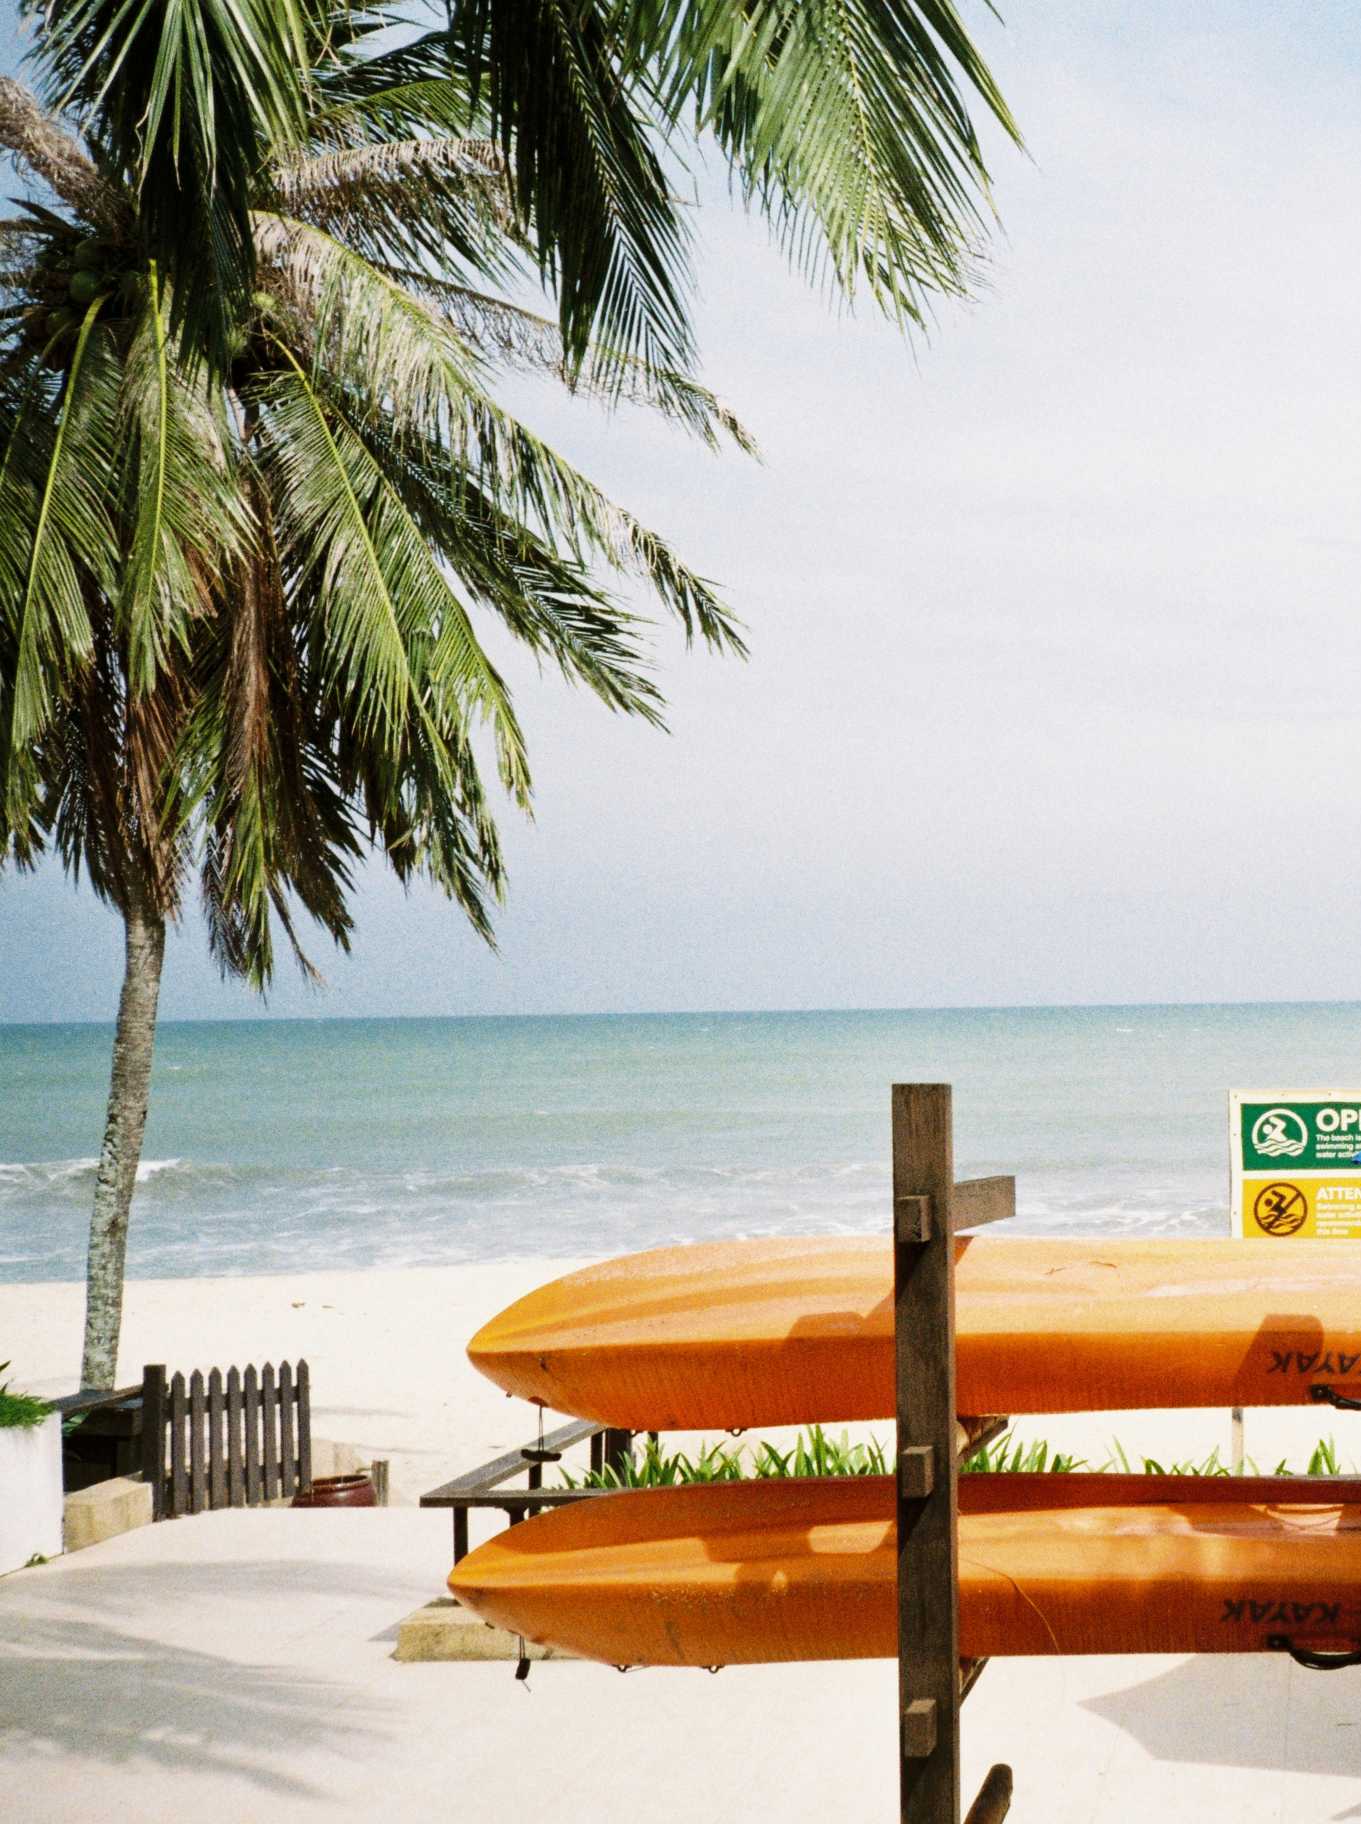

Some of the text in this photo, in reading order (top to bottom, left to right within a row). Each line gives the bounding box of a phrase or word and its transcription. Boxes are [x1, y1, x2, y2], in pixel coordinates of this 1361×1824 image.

[1316, 1134, 1330, 1142] The
[1331, 1134, 1354, 1142] beach
[1354, 1134, 1361, 1142] is
[1316, 1143, 1354, 1152] swimming
[1220, 1599, 1341, 1625] KAYAK
